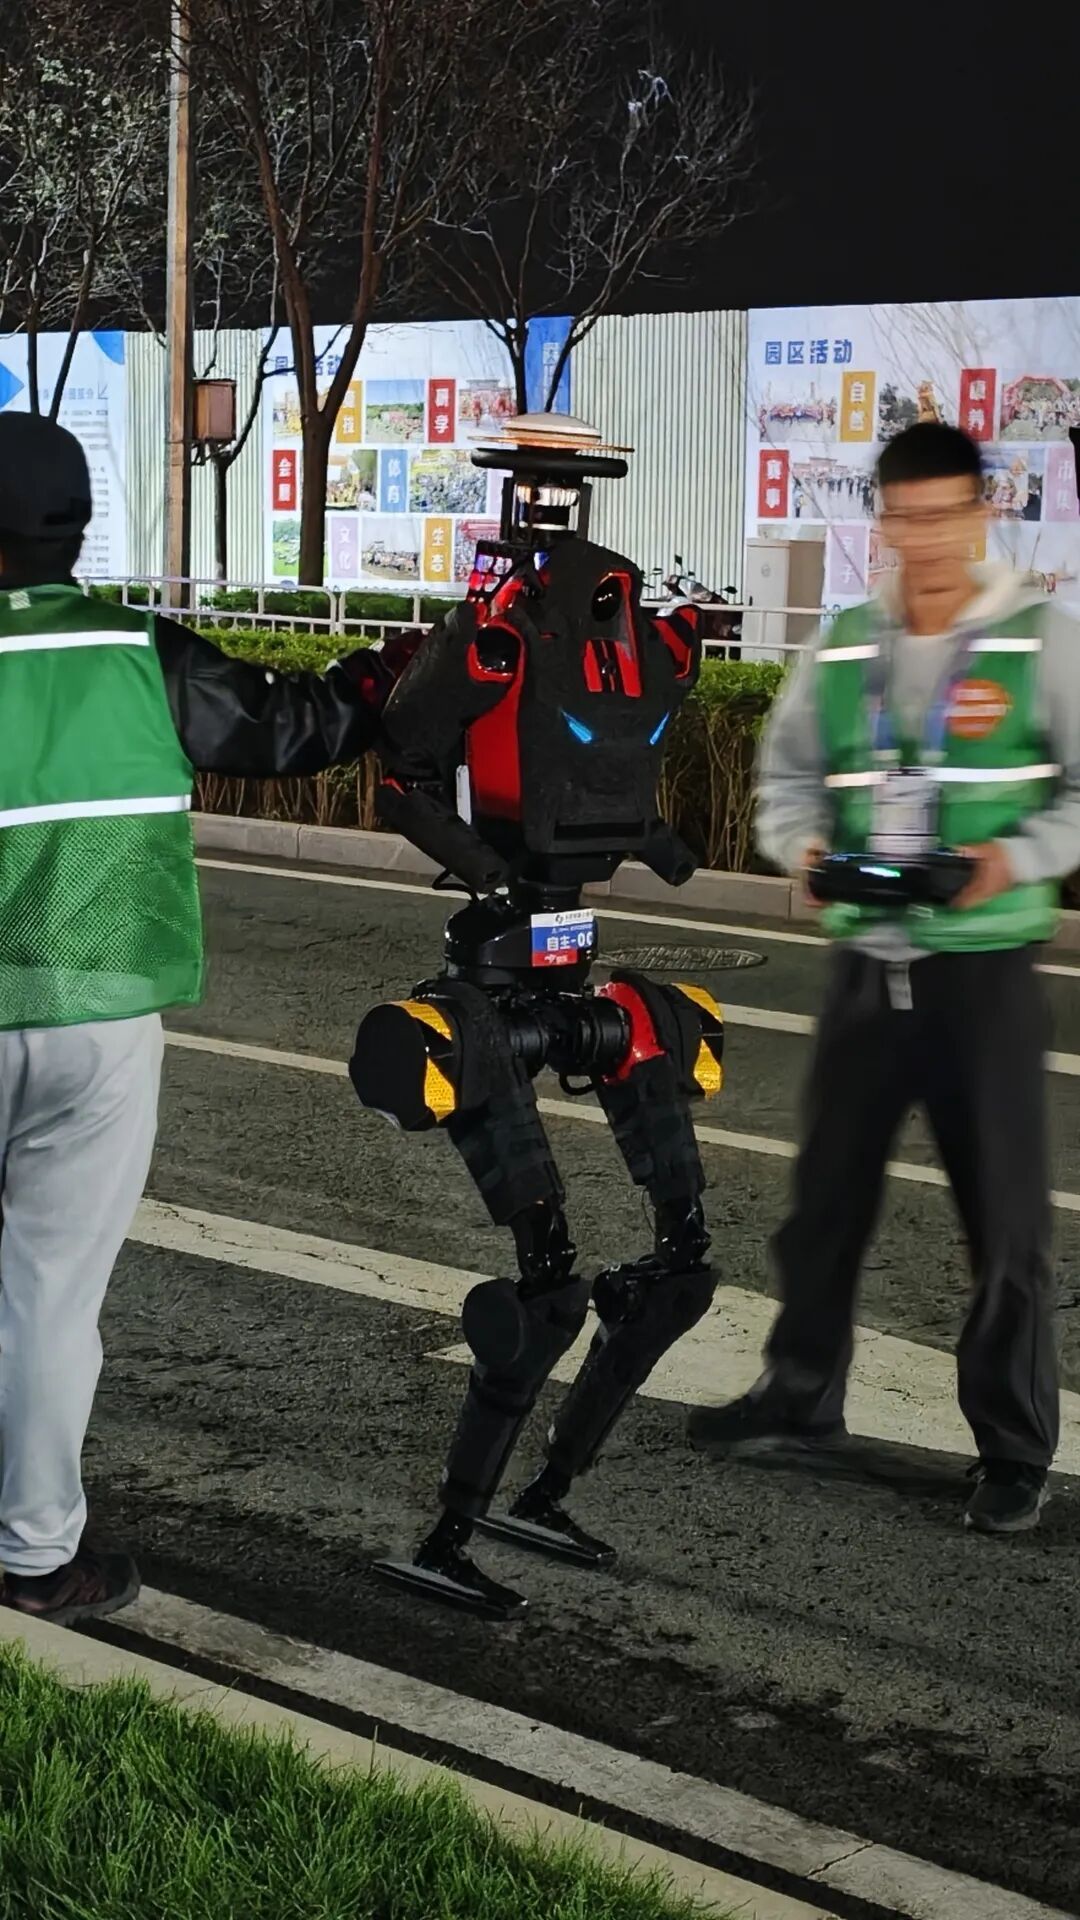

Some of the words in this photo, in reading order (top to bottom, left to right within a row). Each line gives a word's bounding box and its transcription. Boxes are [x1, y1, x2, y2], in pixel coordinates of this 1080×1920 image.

[765, 339, 852, 365] 园区活动
[338, 526, 352, 570] 文化
[431, 527, 445, 573] 生态
